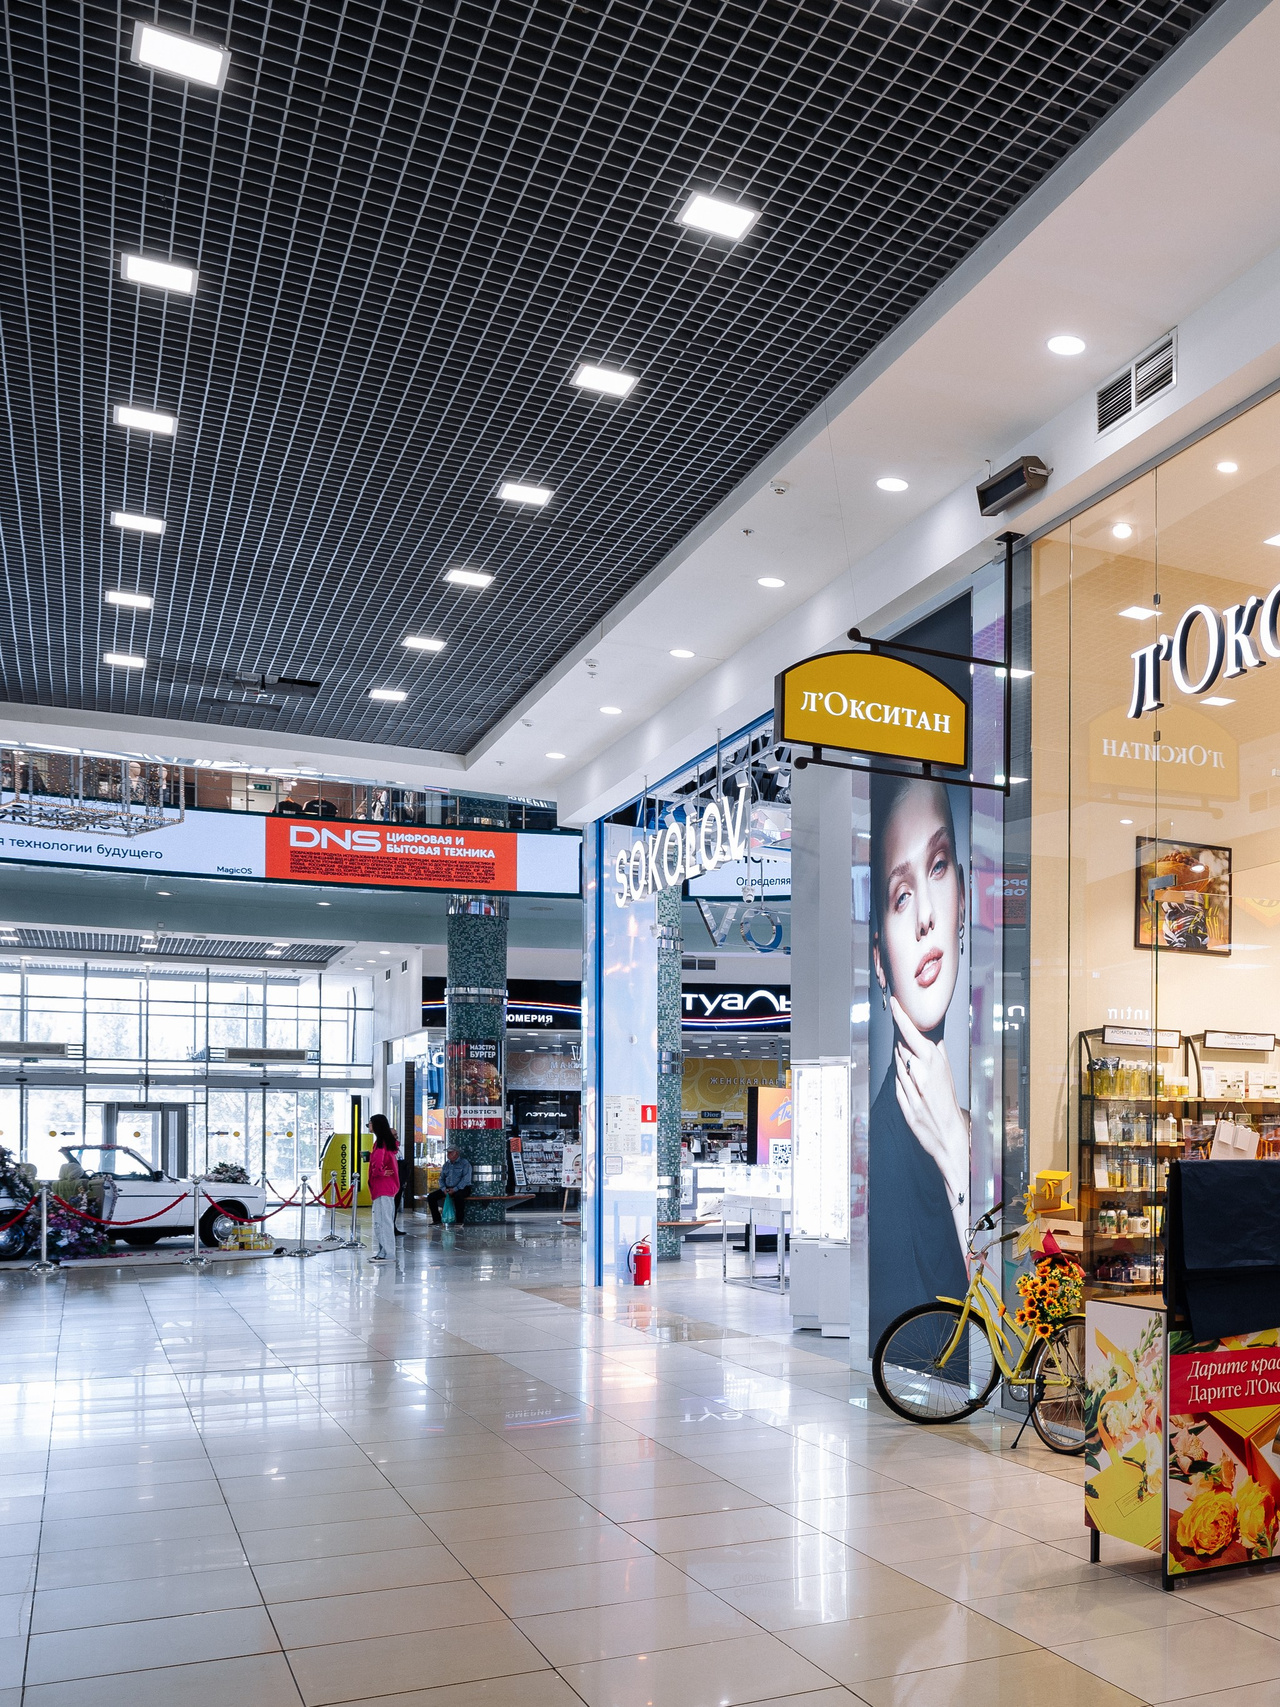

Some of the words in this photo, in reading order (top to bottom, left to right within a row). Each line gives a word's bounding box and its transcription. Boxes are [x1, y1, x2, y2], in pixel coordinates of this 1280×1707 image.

[9, 838, 93, 853] технологии
[96, 844, 164, 860] будущего
[289, 825, 382, 852] DNS
[387, 832, 452, 846] ЦИФРОВАЯ
[455, 836, 465, 846] И
[615, 786, 751, 909] SOKOLOV
[386, 844, 441, 856] БЫТОВАЯ
[443, 847, 496, 859] ТЕХНИКА
[216, 865, 253, 876] MagicOS
[710, 1077, 759, 1085] ЖЕНСКАЯ
[340, 1143, 348, 1193] ТИНЬКОФФ
[1186, 1360, 1249, 1381] Дарите
[1188, 1384, 1242, 1405] Дарите
